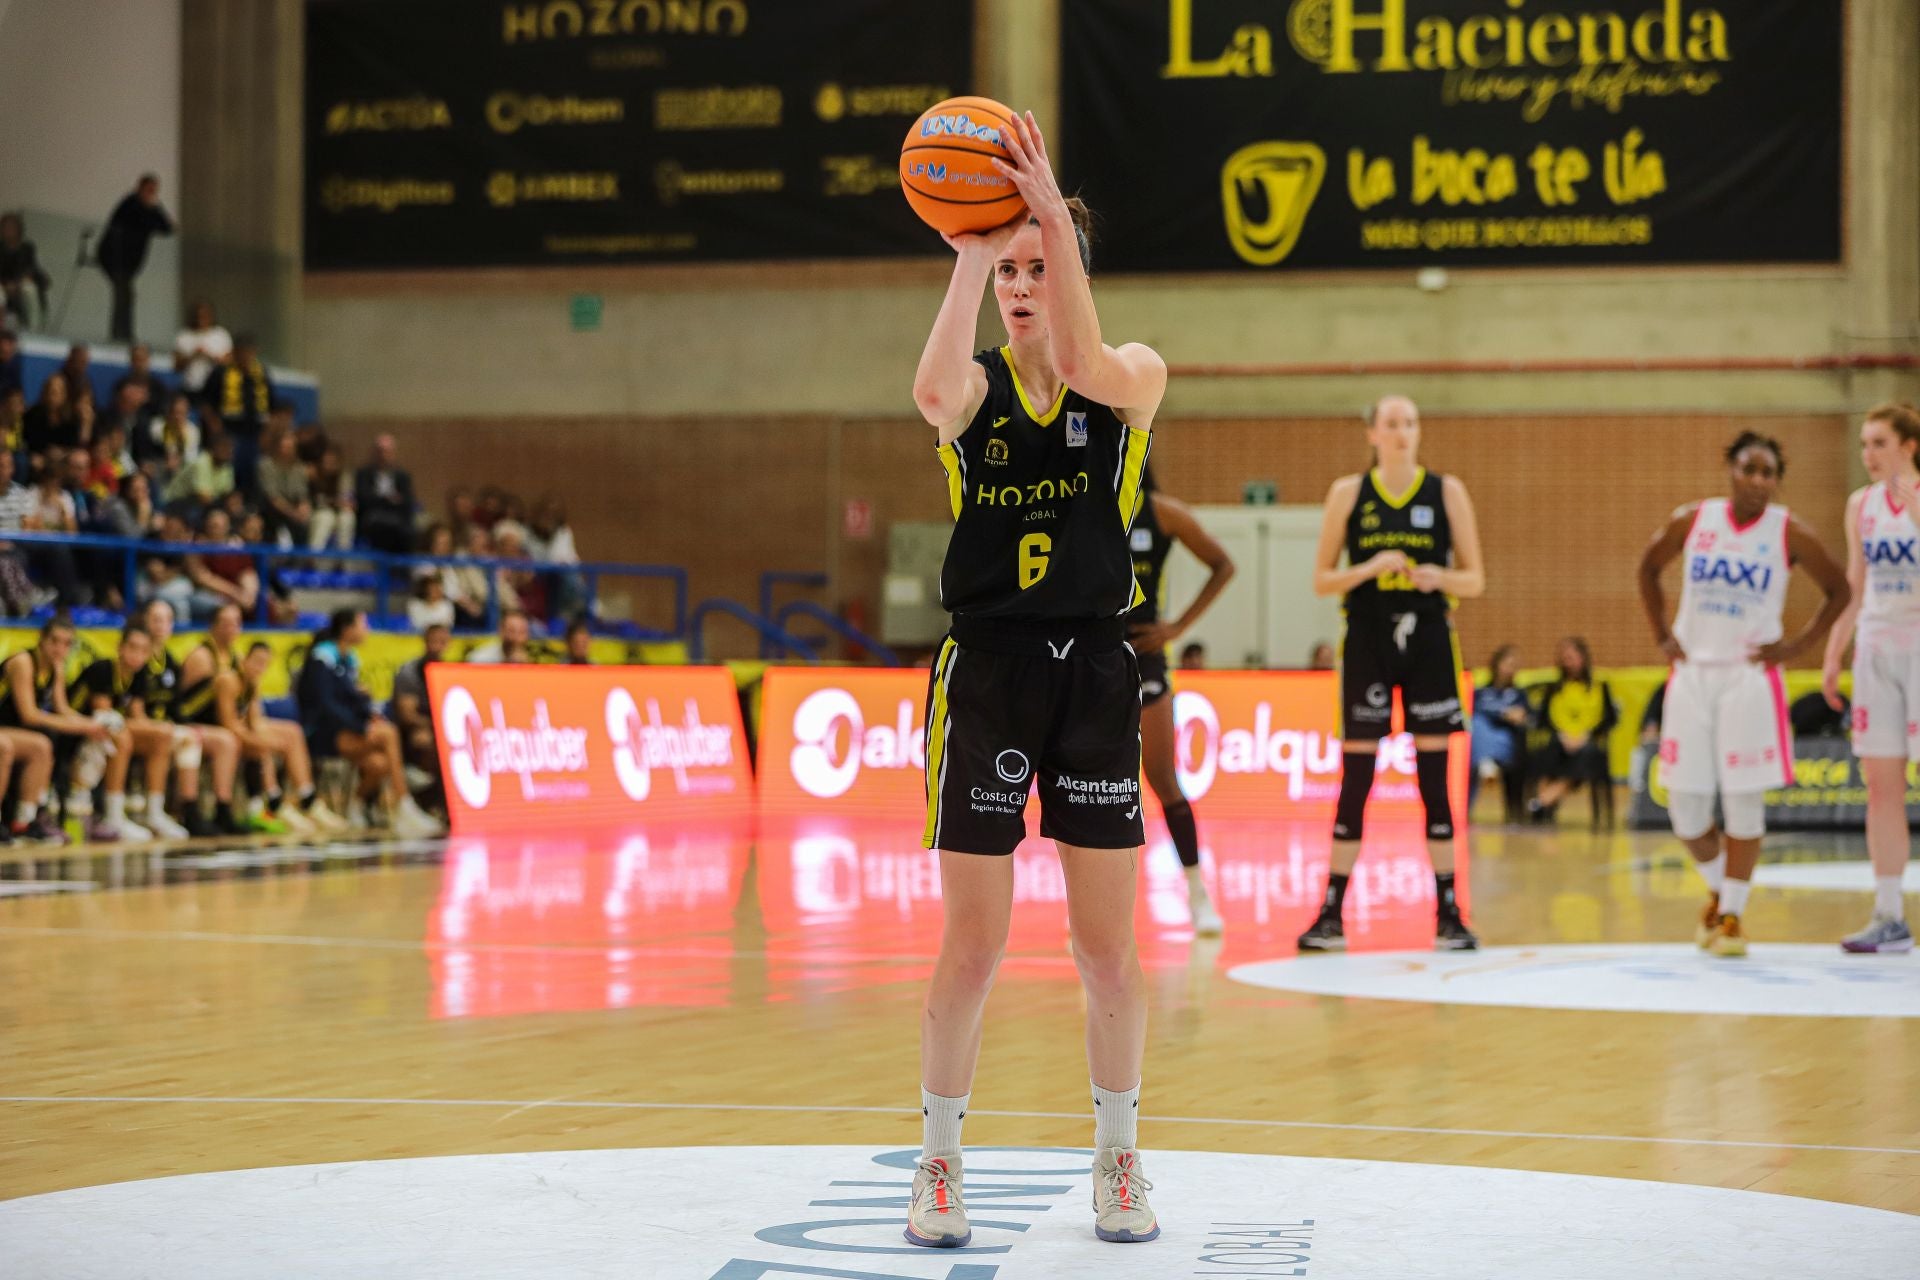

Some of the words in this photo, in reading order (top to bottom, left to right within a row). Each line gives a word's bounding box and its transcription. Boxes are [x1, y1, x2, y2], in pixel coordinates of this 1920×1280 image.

[503, 0, 749, 43] HOZONO
[1162, 0, 1275, 78] La
[1323, 0, 1731, 73] Hacienda
[909, 162, 925, 176] LF
[1528, 143, 1590, 206] te
[977, 472, 1088, 506] HOZONO
[1018, 532, 1052, 590] 6
[1863, 537, 1918, 566] BAX
[1691, 556, 1771, 592] BAXI
[971, 787, 1007, 802] Costa
[971, 803, 994, 813] Región
[1193, 1219, 1314, 1280] LOBAL
